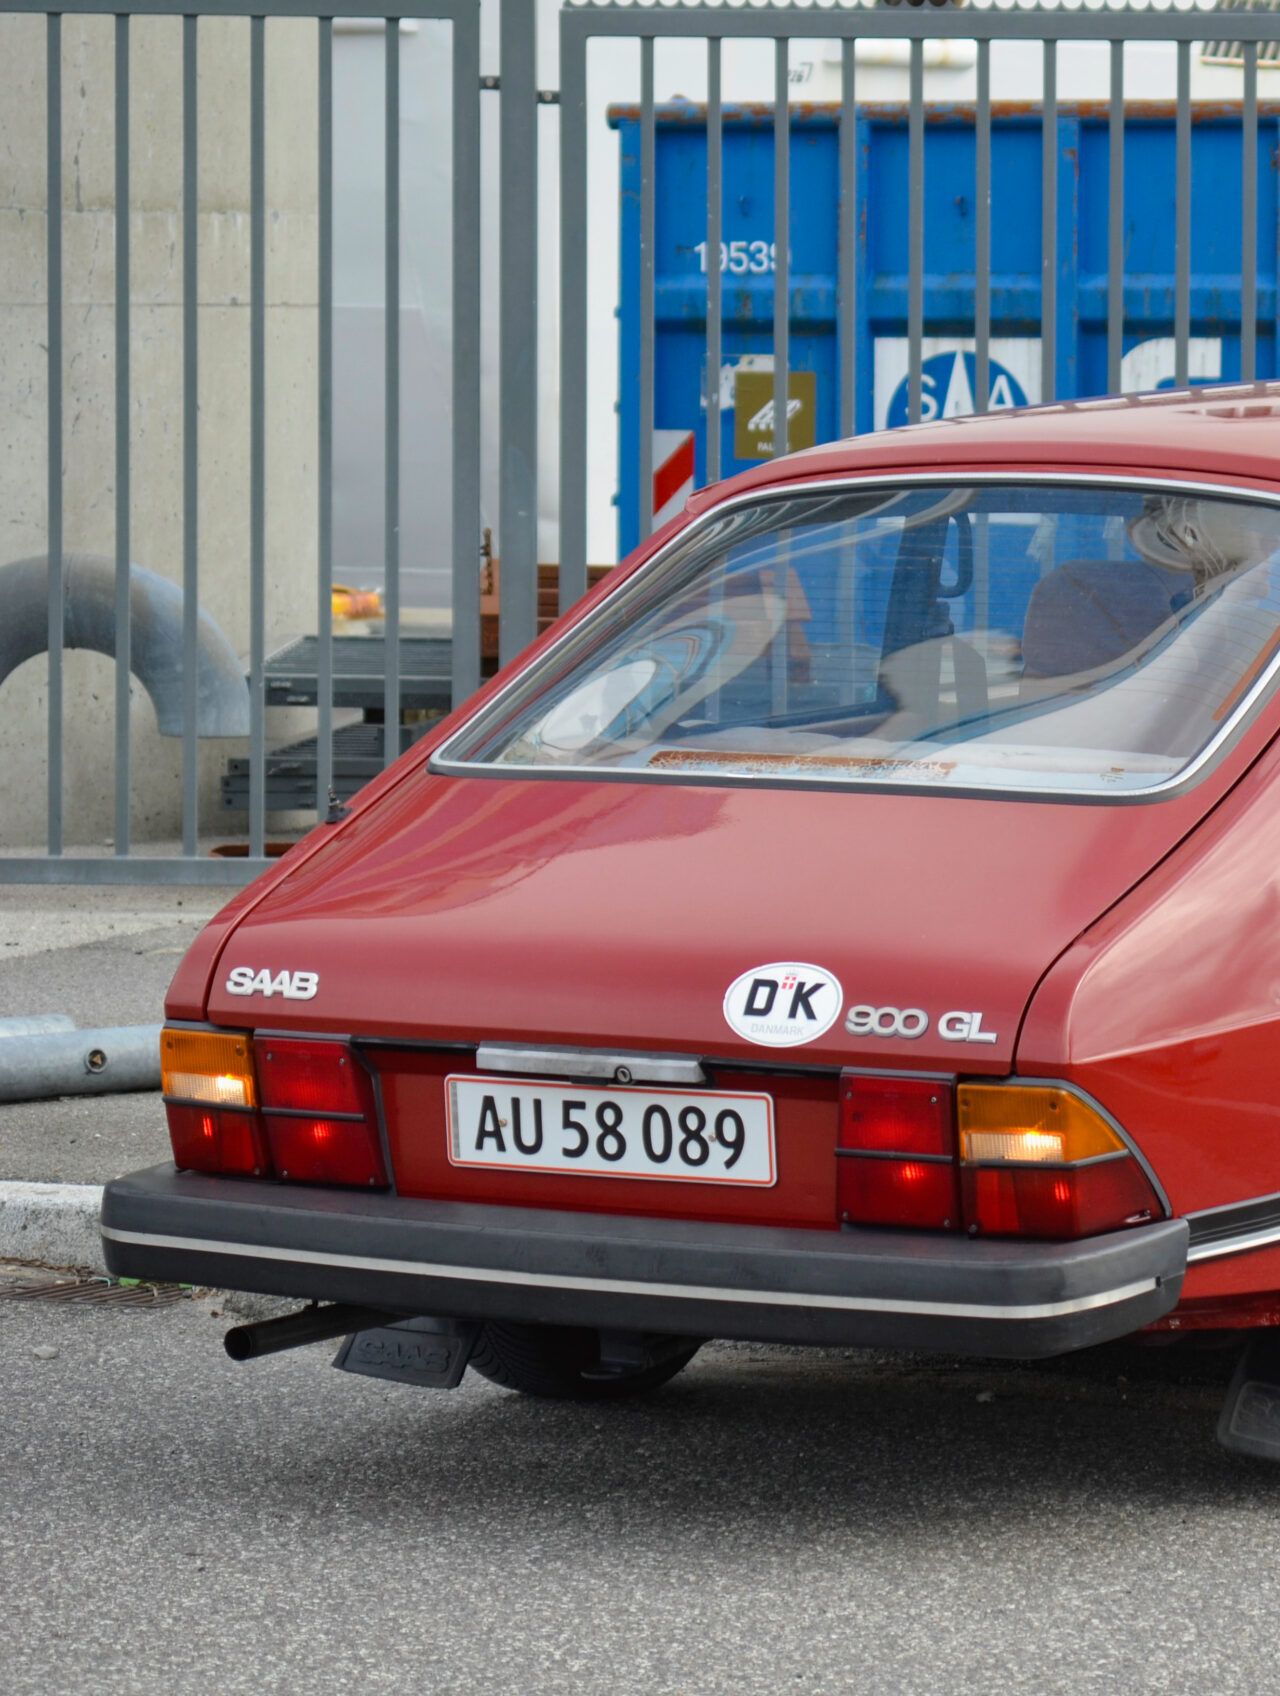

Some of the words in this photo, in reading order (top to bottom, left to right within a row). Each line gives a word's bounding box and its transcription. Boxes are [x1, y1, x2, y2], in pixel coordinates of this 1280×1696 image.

[225, 966, 319, 1000] SAAB
[743, 978, 827, 1021] DK
[750, 1022, 805, 1037] DANMARK
[845, 1004, 929, 1039] 900
[937, 1010, 998, 1044] GL
[475, 1095, 543, 1155] AU
[561, 1100, 627, 1162] 58
[642, 1103, 746, 1170] 089
[354, 1338, 453, 1374] SAAB
